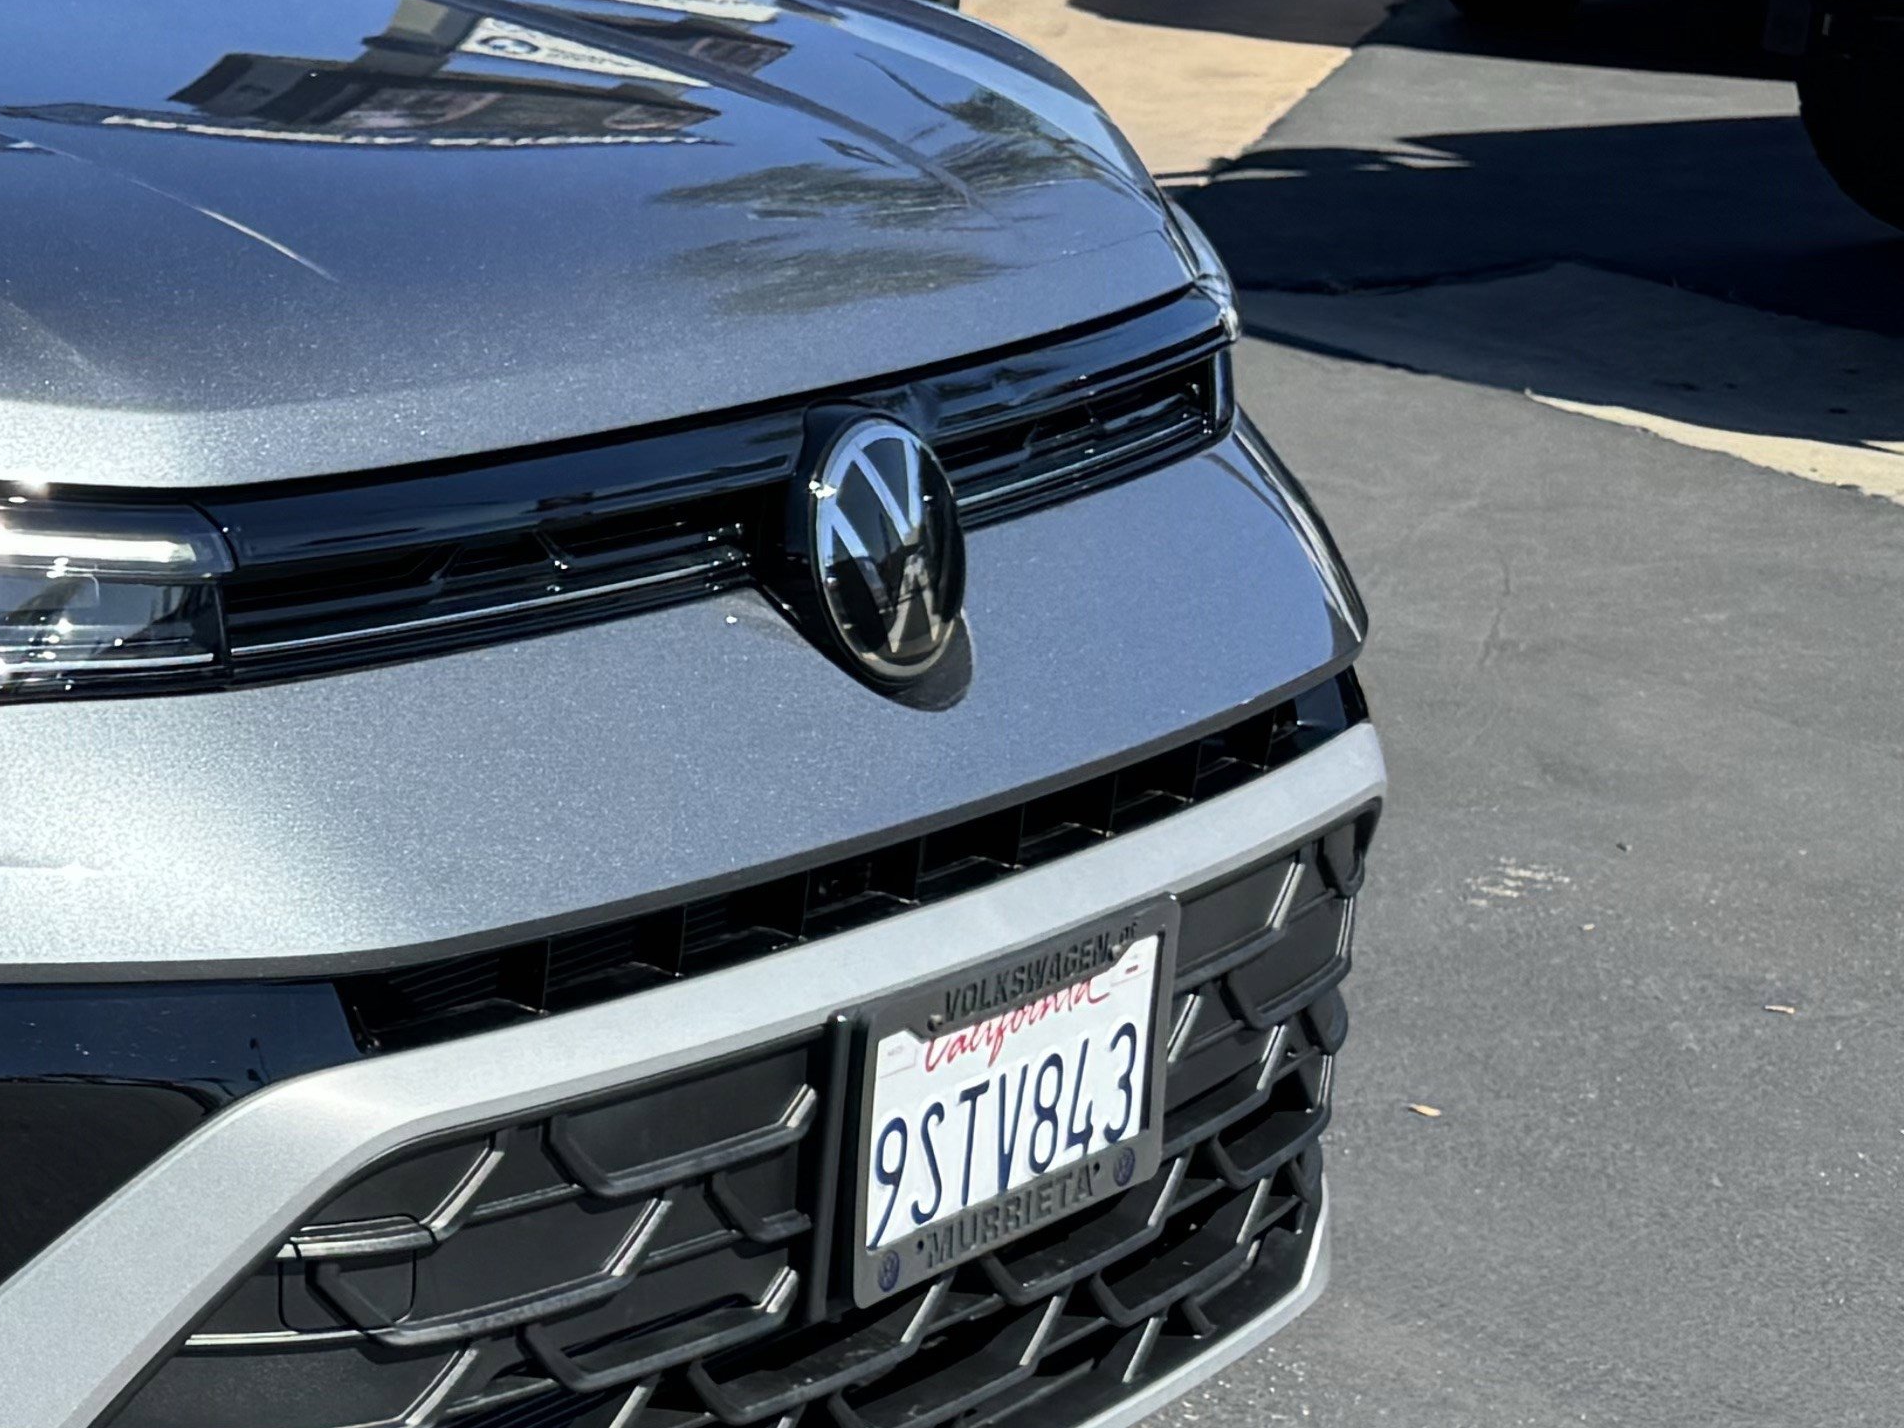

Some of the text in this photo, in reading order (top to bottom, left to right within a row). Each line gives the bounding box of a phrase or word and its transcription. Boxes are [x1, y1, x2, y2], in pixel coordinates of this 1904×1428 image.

[944, 932, 1115, 1023] VOLKSWAGEN
[866, 1021, 1137, 1252] 9STV843
[926, 1163, 1094, 1269] MURRIETA
